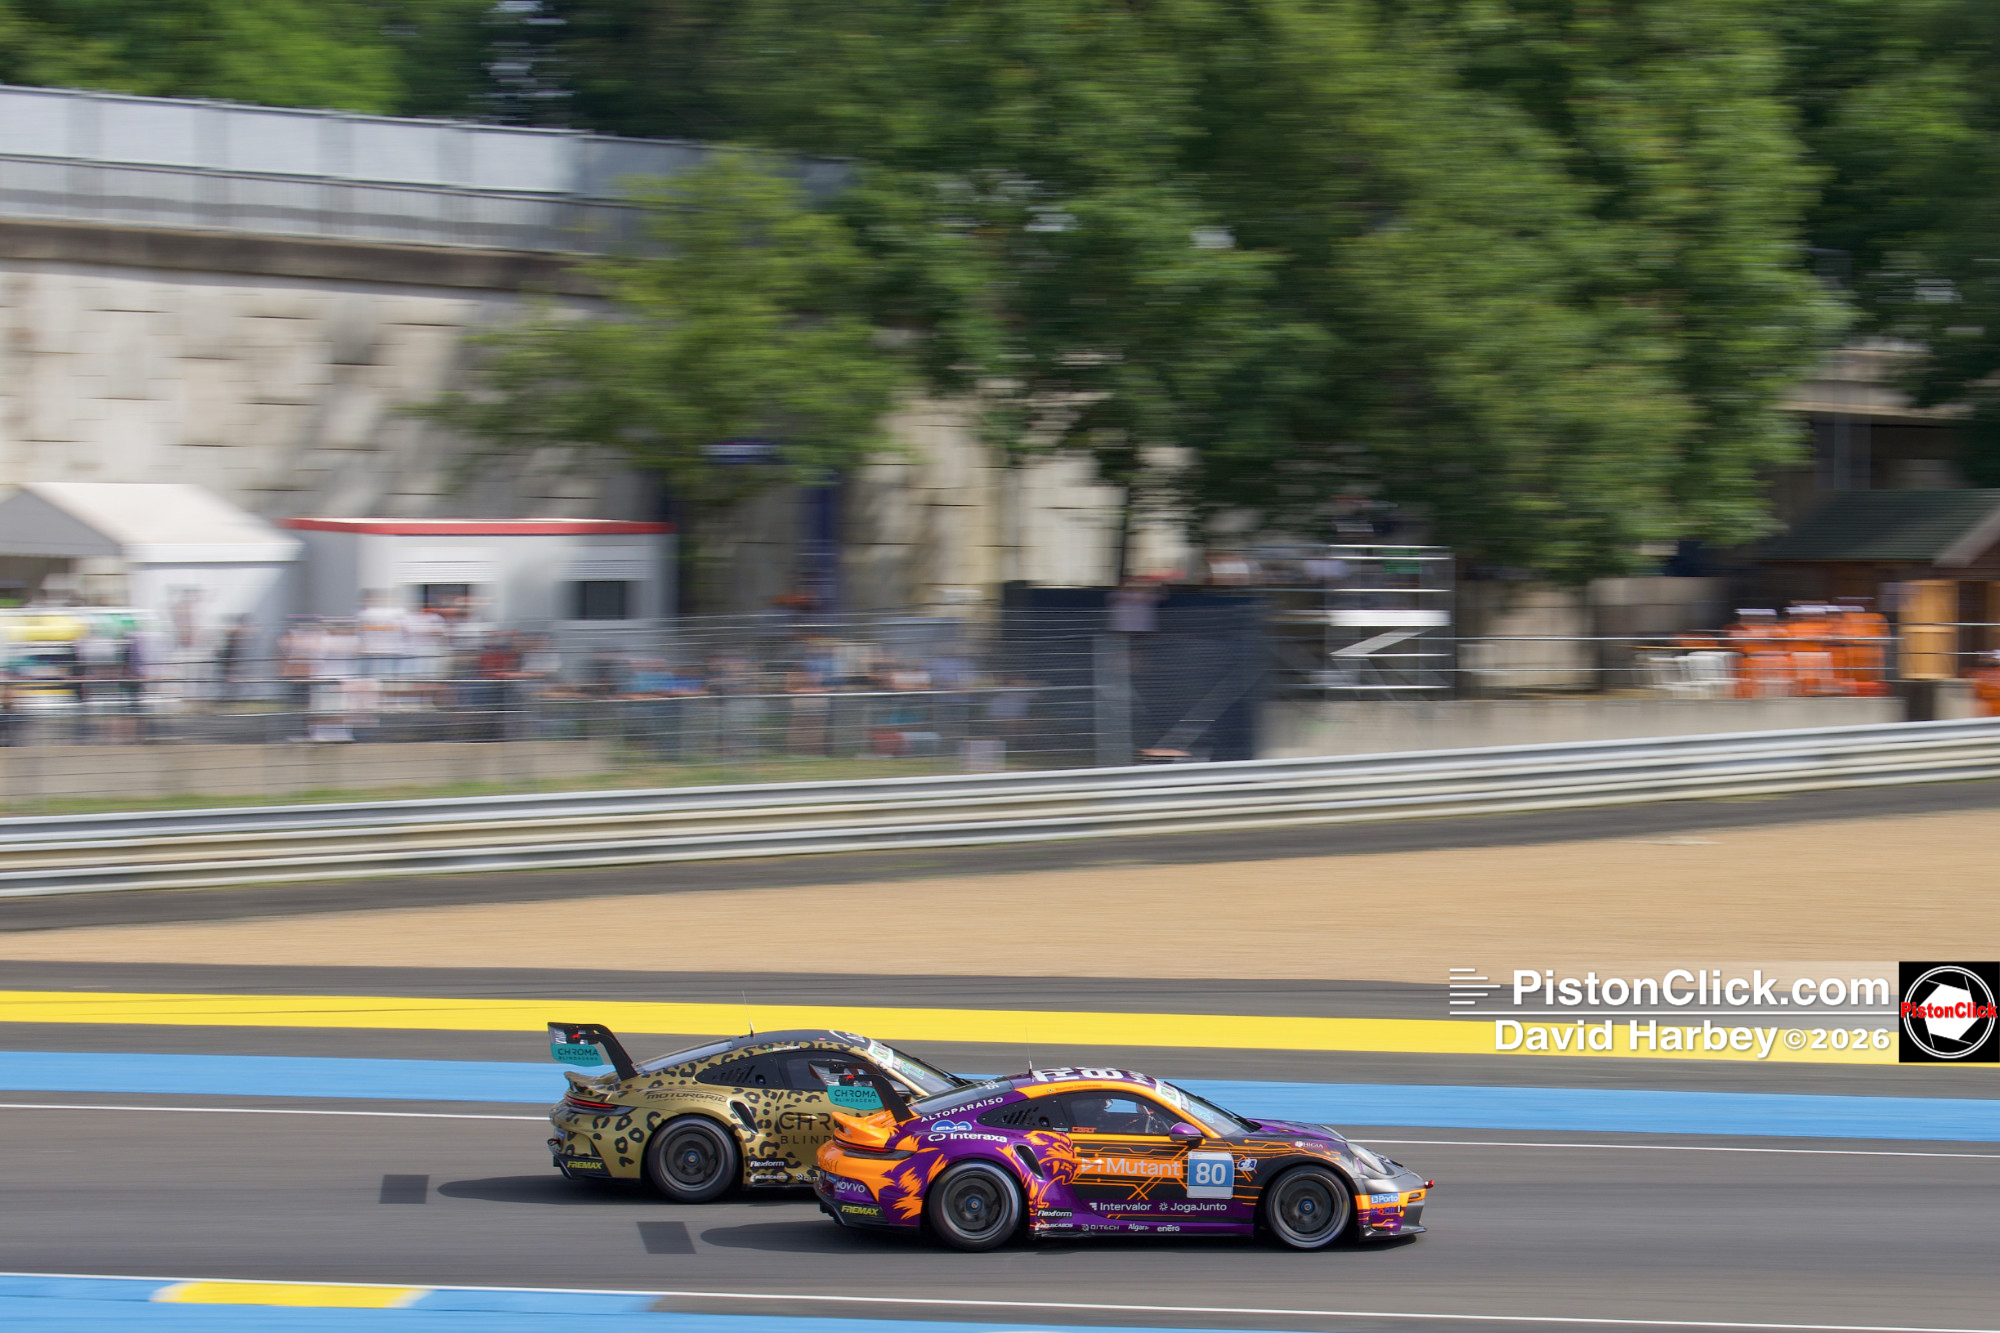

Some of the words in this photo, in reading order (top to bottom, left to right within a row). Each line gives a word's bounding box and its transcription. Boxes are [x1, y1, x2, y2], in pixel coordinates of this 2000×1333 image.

[557, 1048, 599, 1056] CHROMA
[834, 1089, 877, 1098] CHROMA
[780, 1135, 832, 1145] BLIND
[949, 1132, 1008, 1143] Interaxa
[567, 1160, 603, 1169] FREMAX
[1106, 1157, 1181, 1177] Mutant
[1195, 1162, 1227, 1185] 80
[1379, 1194, 1399, 1203] Porto
[841, 1205, 879, 1216] FREMAX
[1100, 1202, 1152, 1211] Intervalor
[1170, 1202, 1227, 1213] JogaJunto
